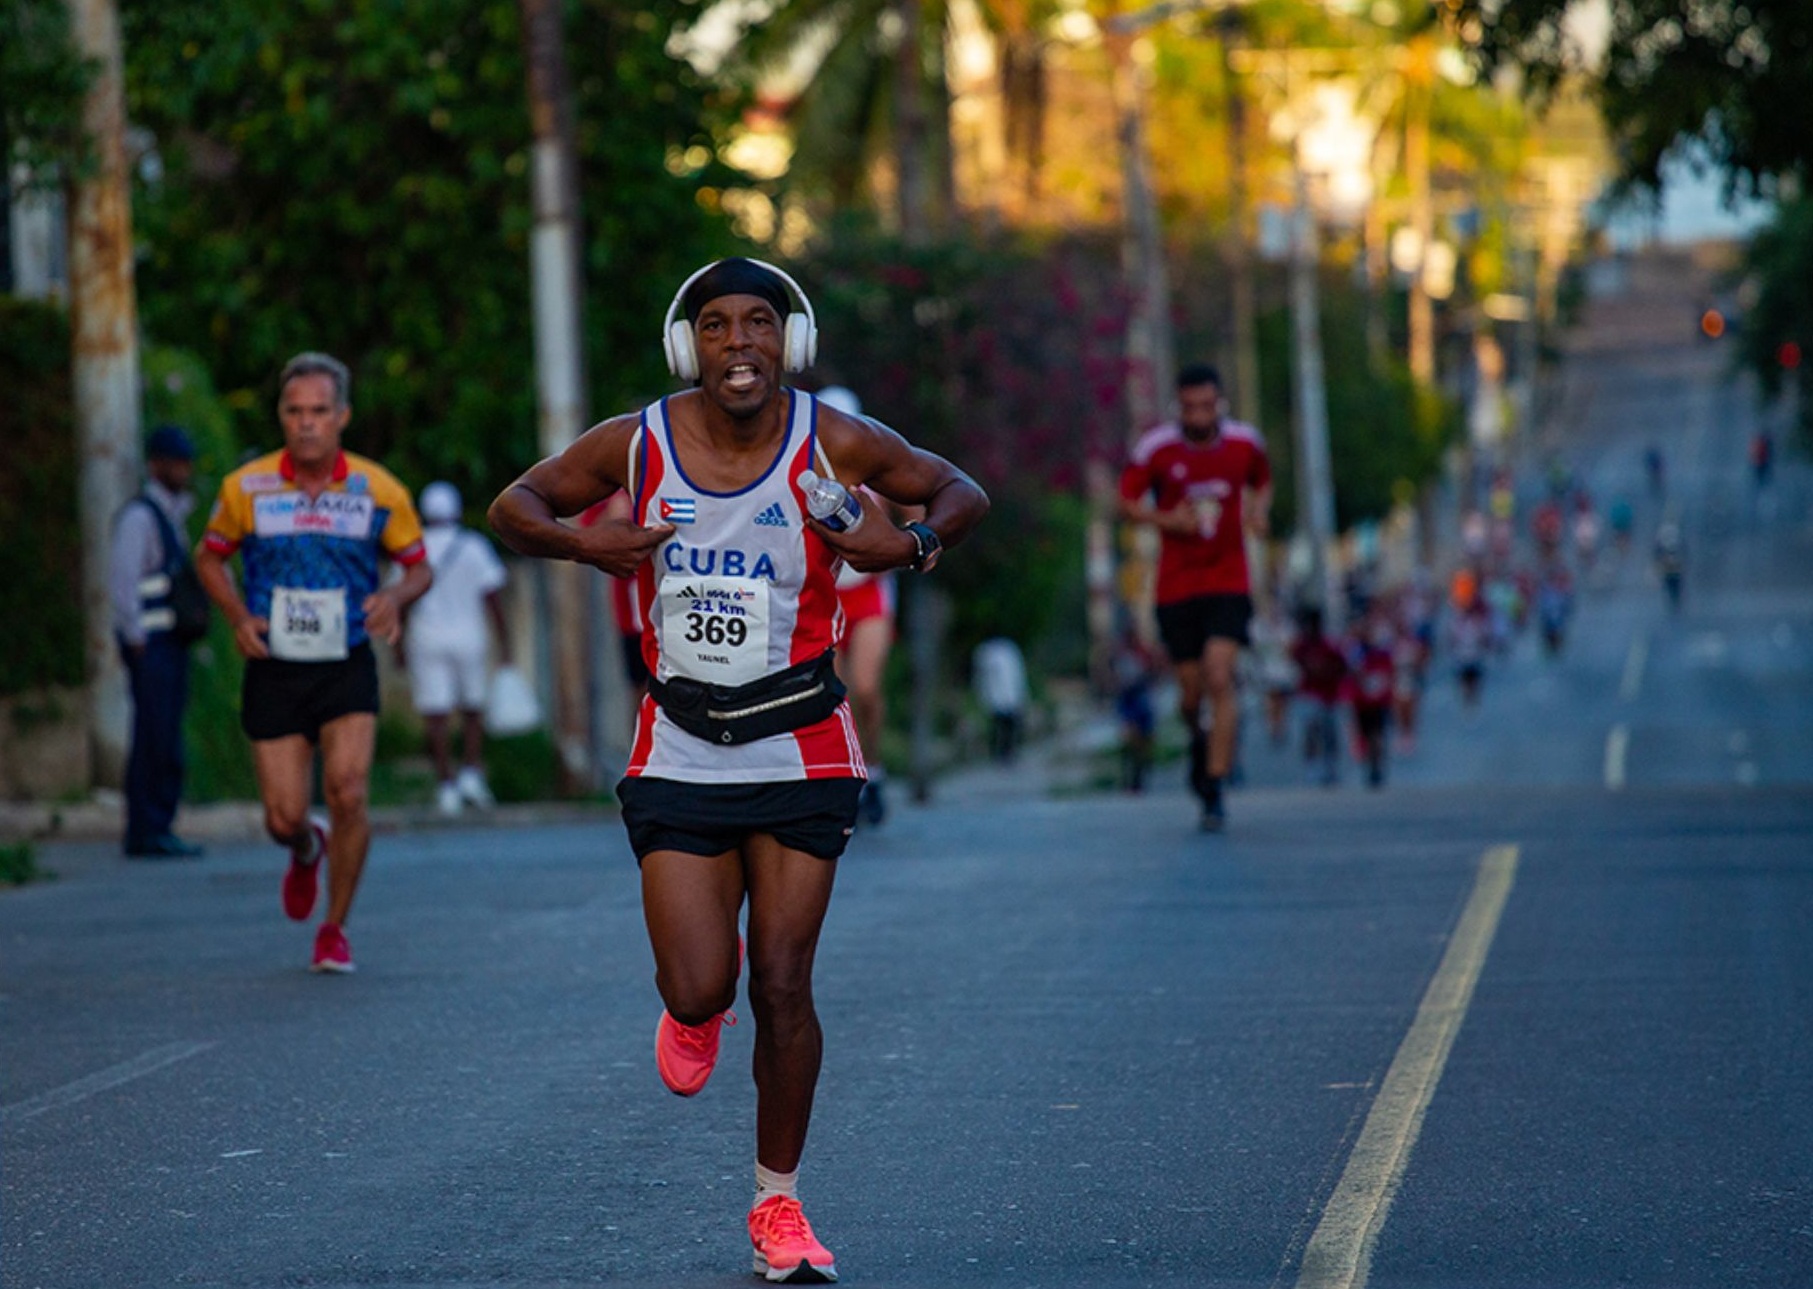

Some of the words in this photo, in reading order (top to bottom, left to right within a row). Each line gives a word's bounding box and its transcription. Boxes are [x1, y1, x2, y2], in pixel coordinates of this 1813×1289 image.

[754, 516, 789, 528] adidas
[664, 541, 776, 581] CUBA
[691, 598, 713, 612] 21
[718, 601, 746, 616] km
[684, 612, 747, 647] 369
